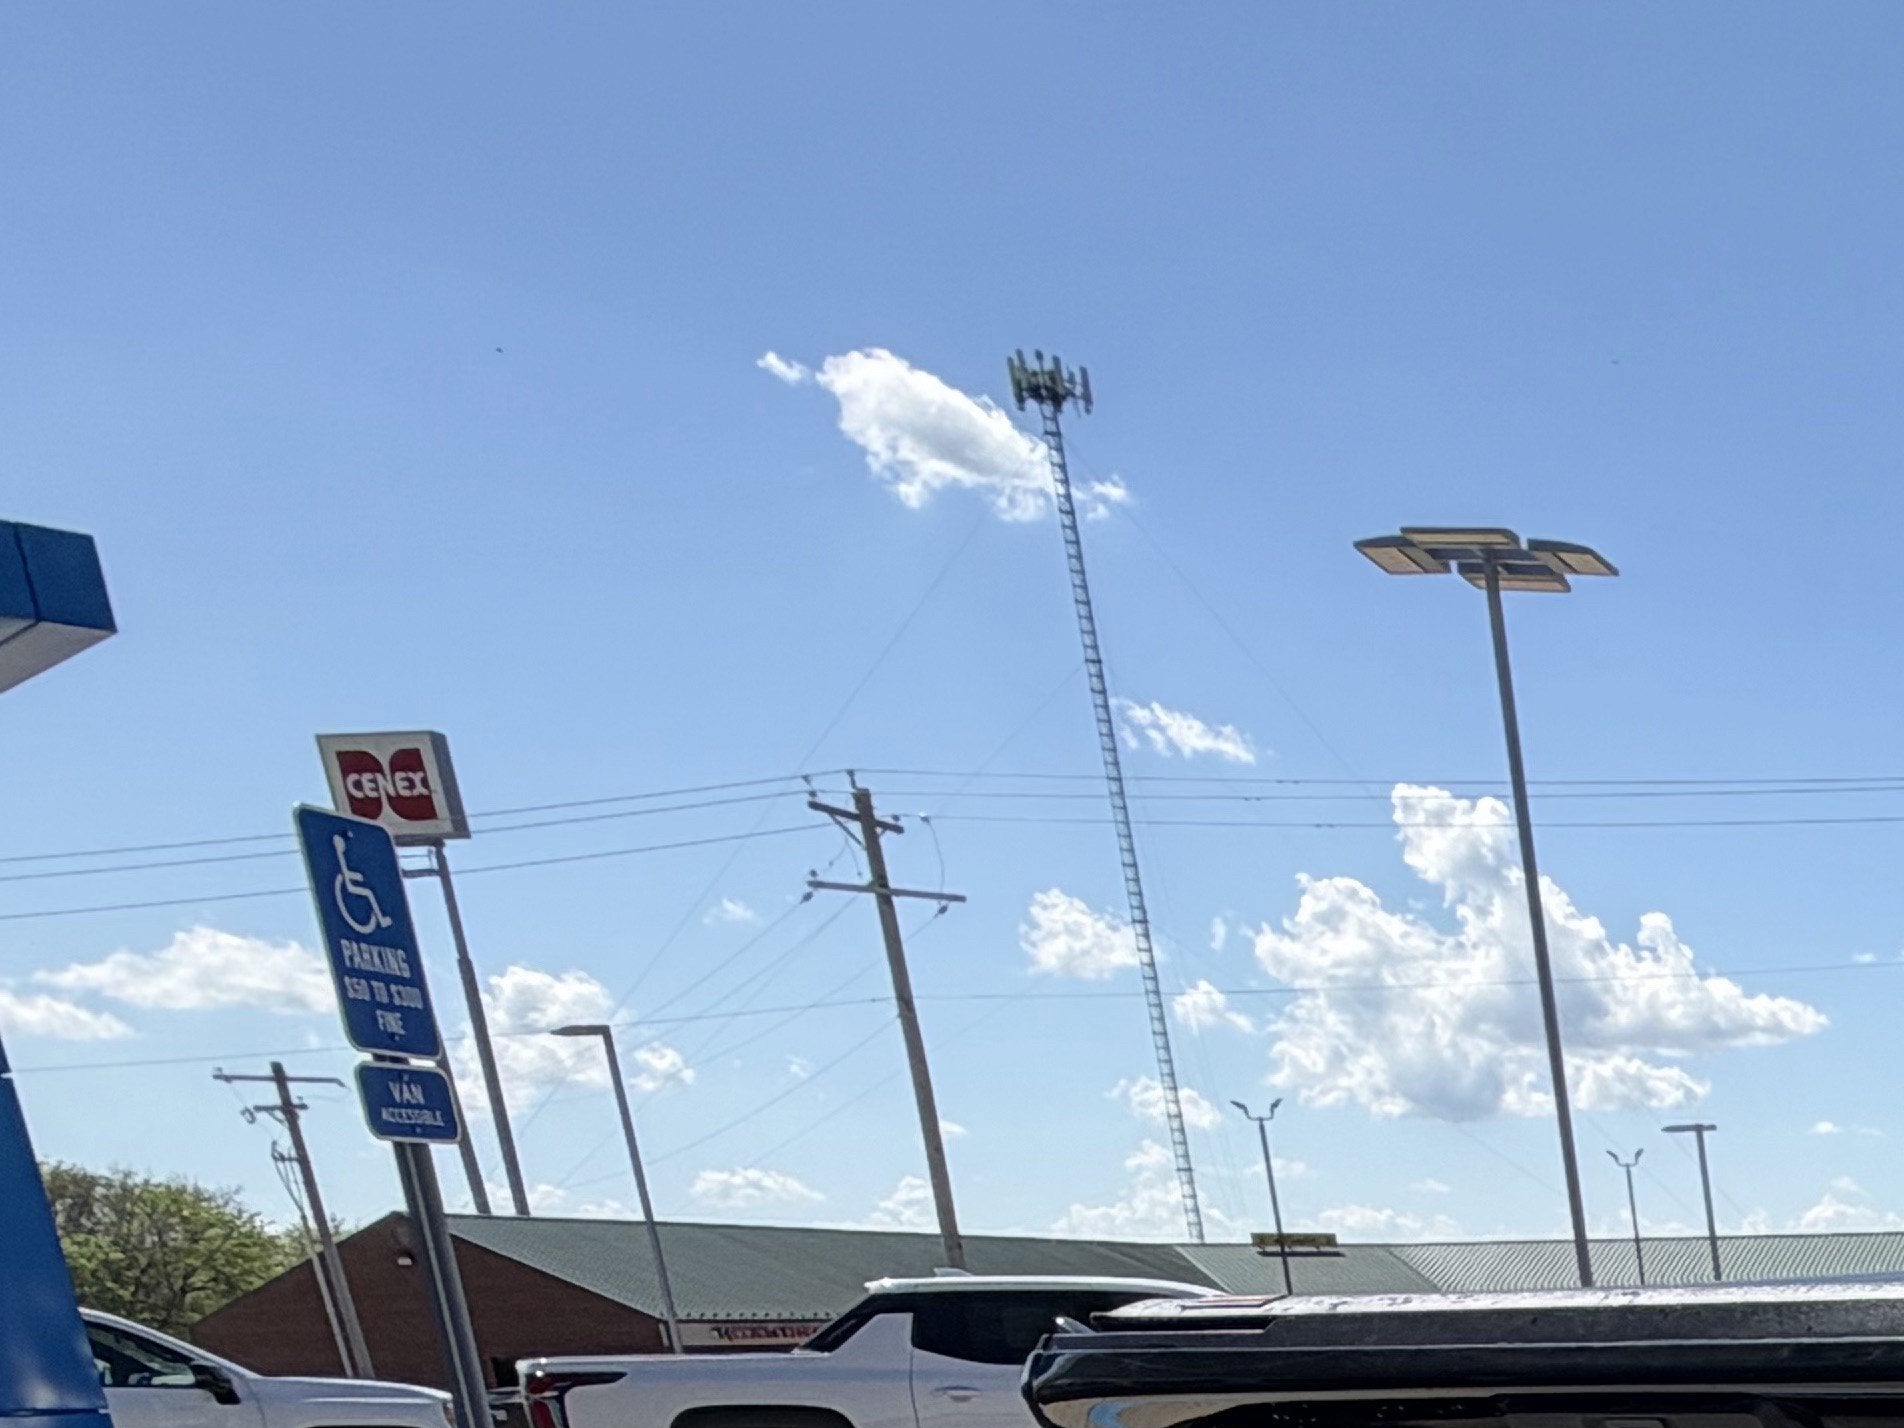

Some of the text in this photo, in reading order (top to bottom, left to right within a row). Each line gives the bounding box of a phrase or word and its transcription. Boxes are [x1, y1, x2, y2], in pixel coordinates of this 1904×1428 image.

[346, 771, 431, 799] CENEX
[340, 938, 411, 978] PARKING
[388, 1080, 426, 1105] VAN
